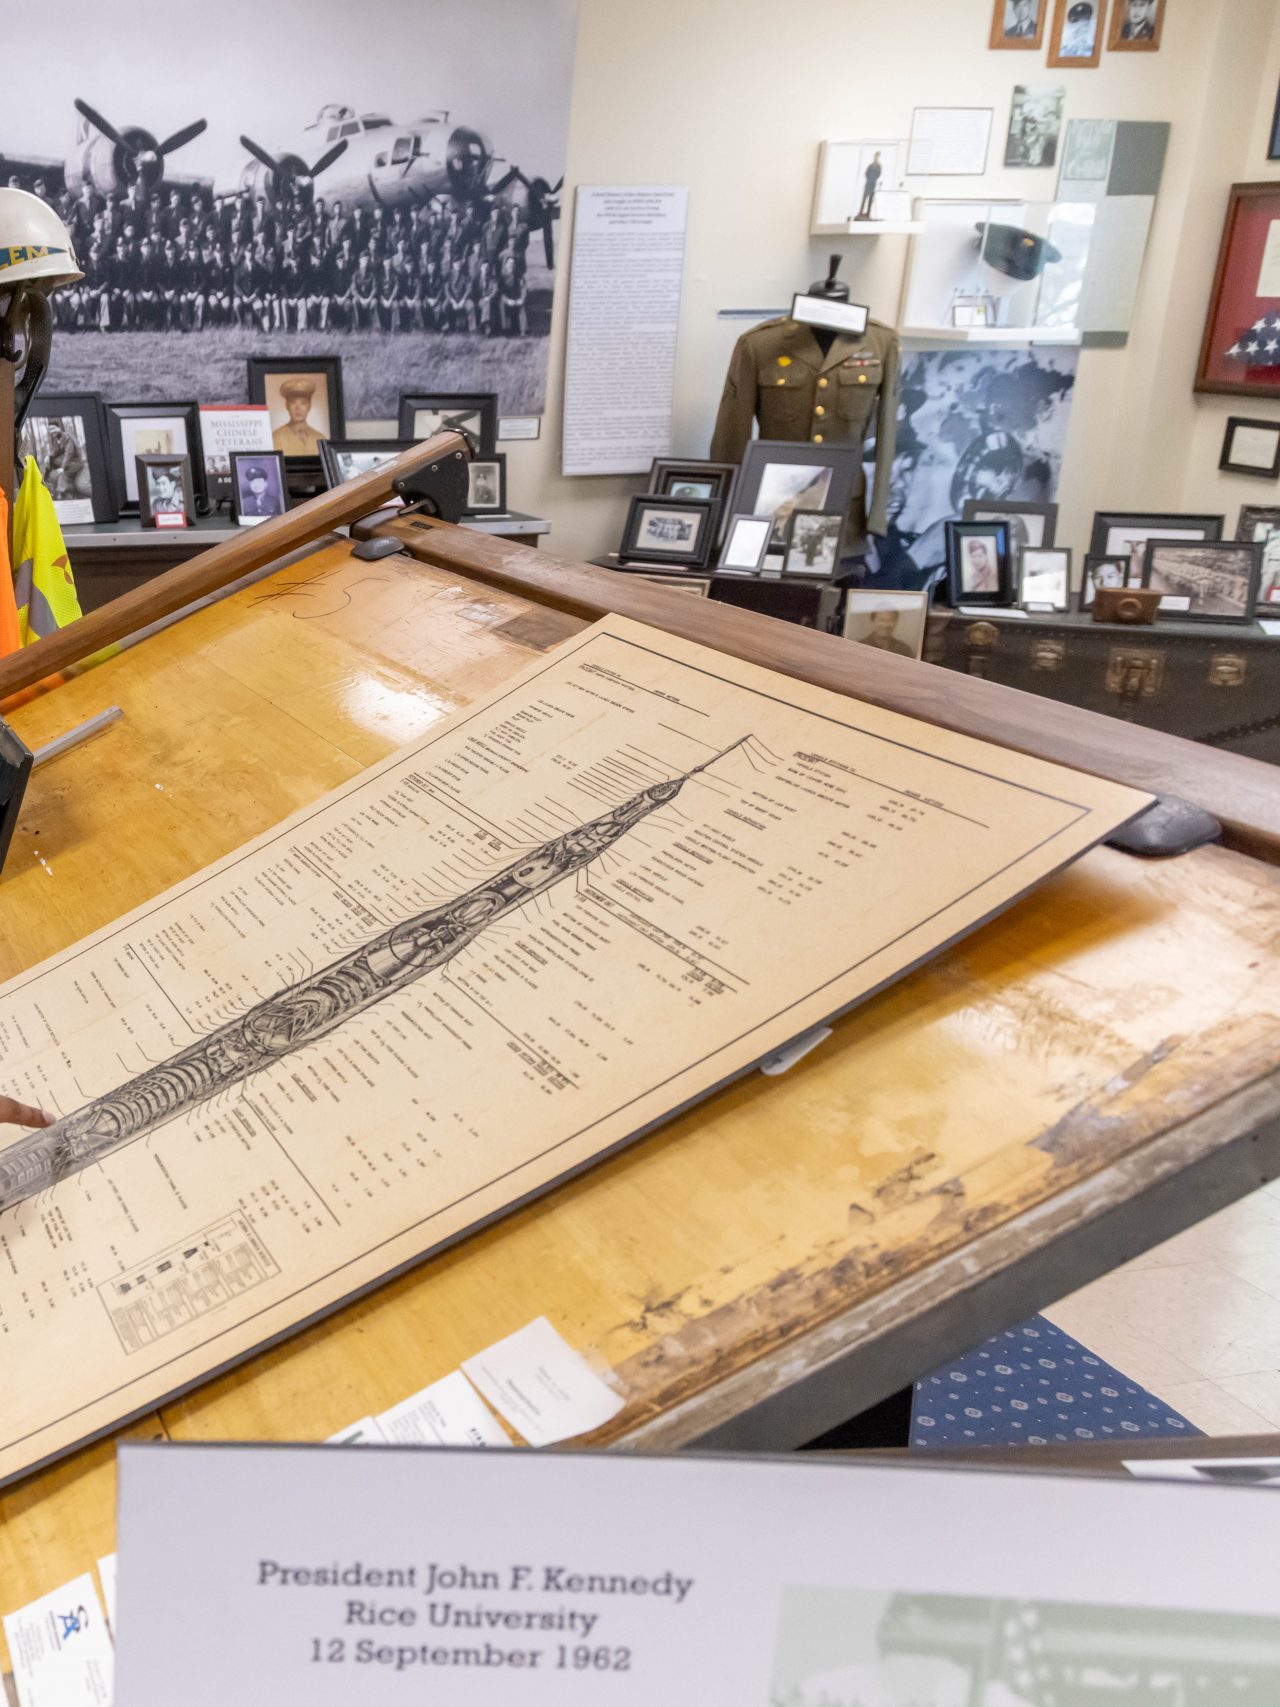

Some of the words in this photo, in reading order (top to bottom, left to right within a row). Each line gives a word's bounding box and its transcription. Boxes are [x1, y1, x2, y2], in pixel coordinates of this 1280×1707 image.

[210, 420, 263, 428] MISSISSIPPI
[217, 429, 257, 437] CHINESE
[214, 437, 263, 446] VETERANS
[257, 1560, 417, 1588] President
[424, 1564, 500, 1595] John
[509, 1566, 534, 1592] F.
[542, 1567, 694, 1603] Kennedy
[345, 1601, 417, 1627] Rice
[428, 1603, 598, 1637] University
[310, 1638, 346, 1664] 12
[354, 1639, 543, 1671] September
[556, 1645, 632, 1672] 1962
